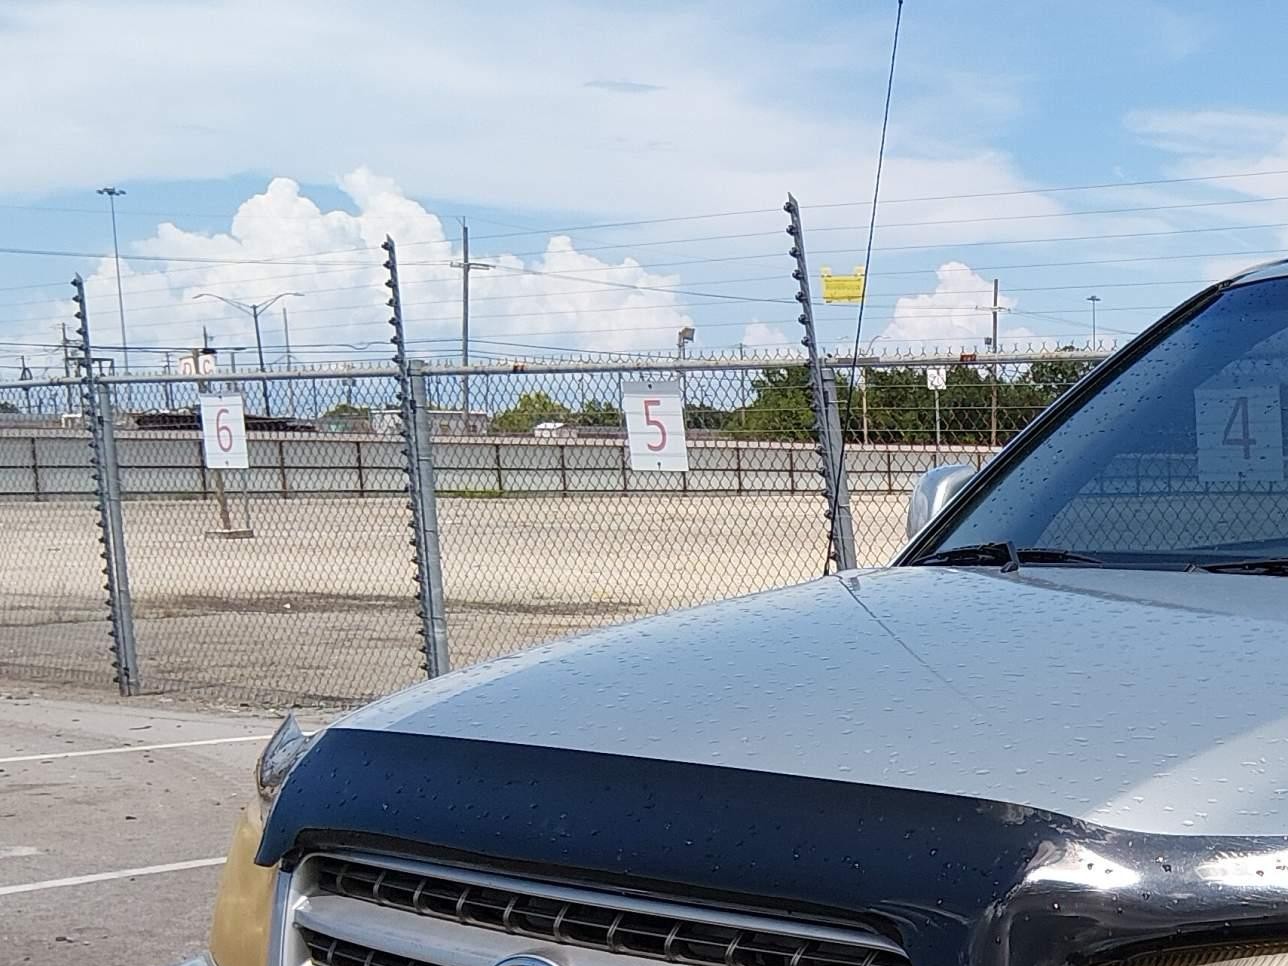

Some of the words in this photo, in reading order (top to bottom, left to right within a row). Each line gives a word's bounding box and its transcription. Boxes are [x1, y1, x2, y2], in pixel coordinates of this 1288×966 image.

[216, 408, 233, 453] 6
[643, 399, 667, 452] 5
[1222, 396, 1257, 460] 4
